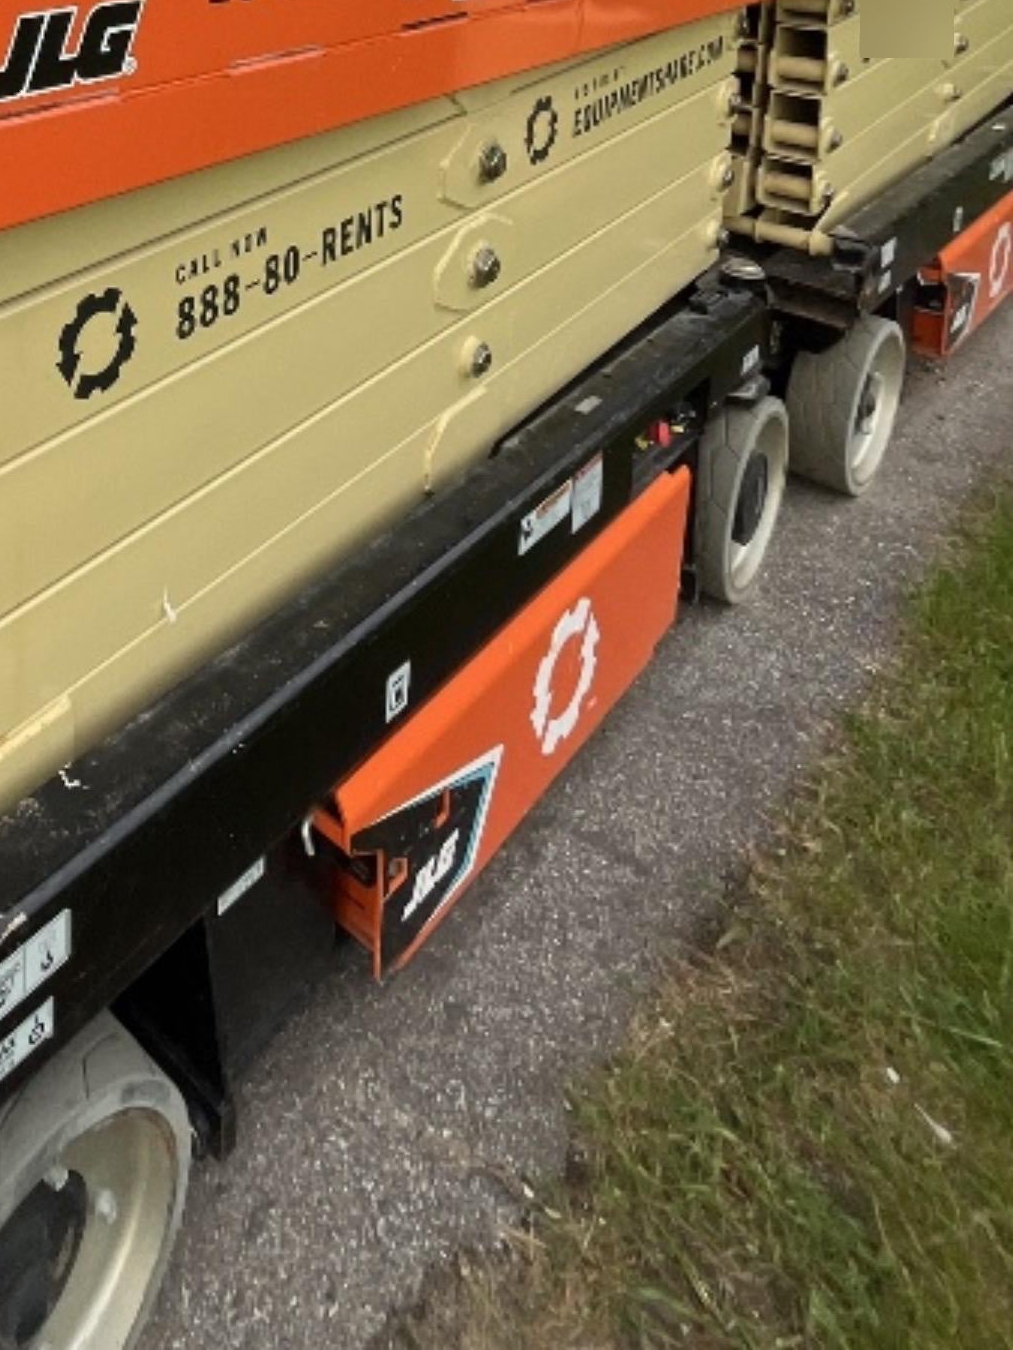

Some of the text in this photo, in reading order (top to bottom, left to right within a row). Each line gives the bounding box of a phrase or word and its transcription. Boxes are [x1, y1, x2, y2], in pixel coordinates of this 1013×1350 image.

[175, 248, 222, 286] CALL
[175, 194, 403, 341] 888-80-RENTS
[400, 827, 460, 923] JLG
